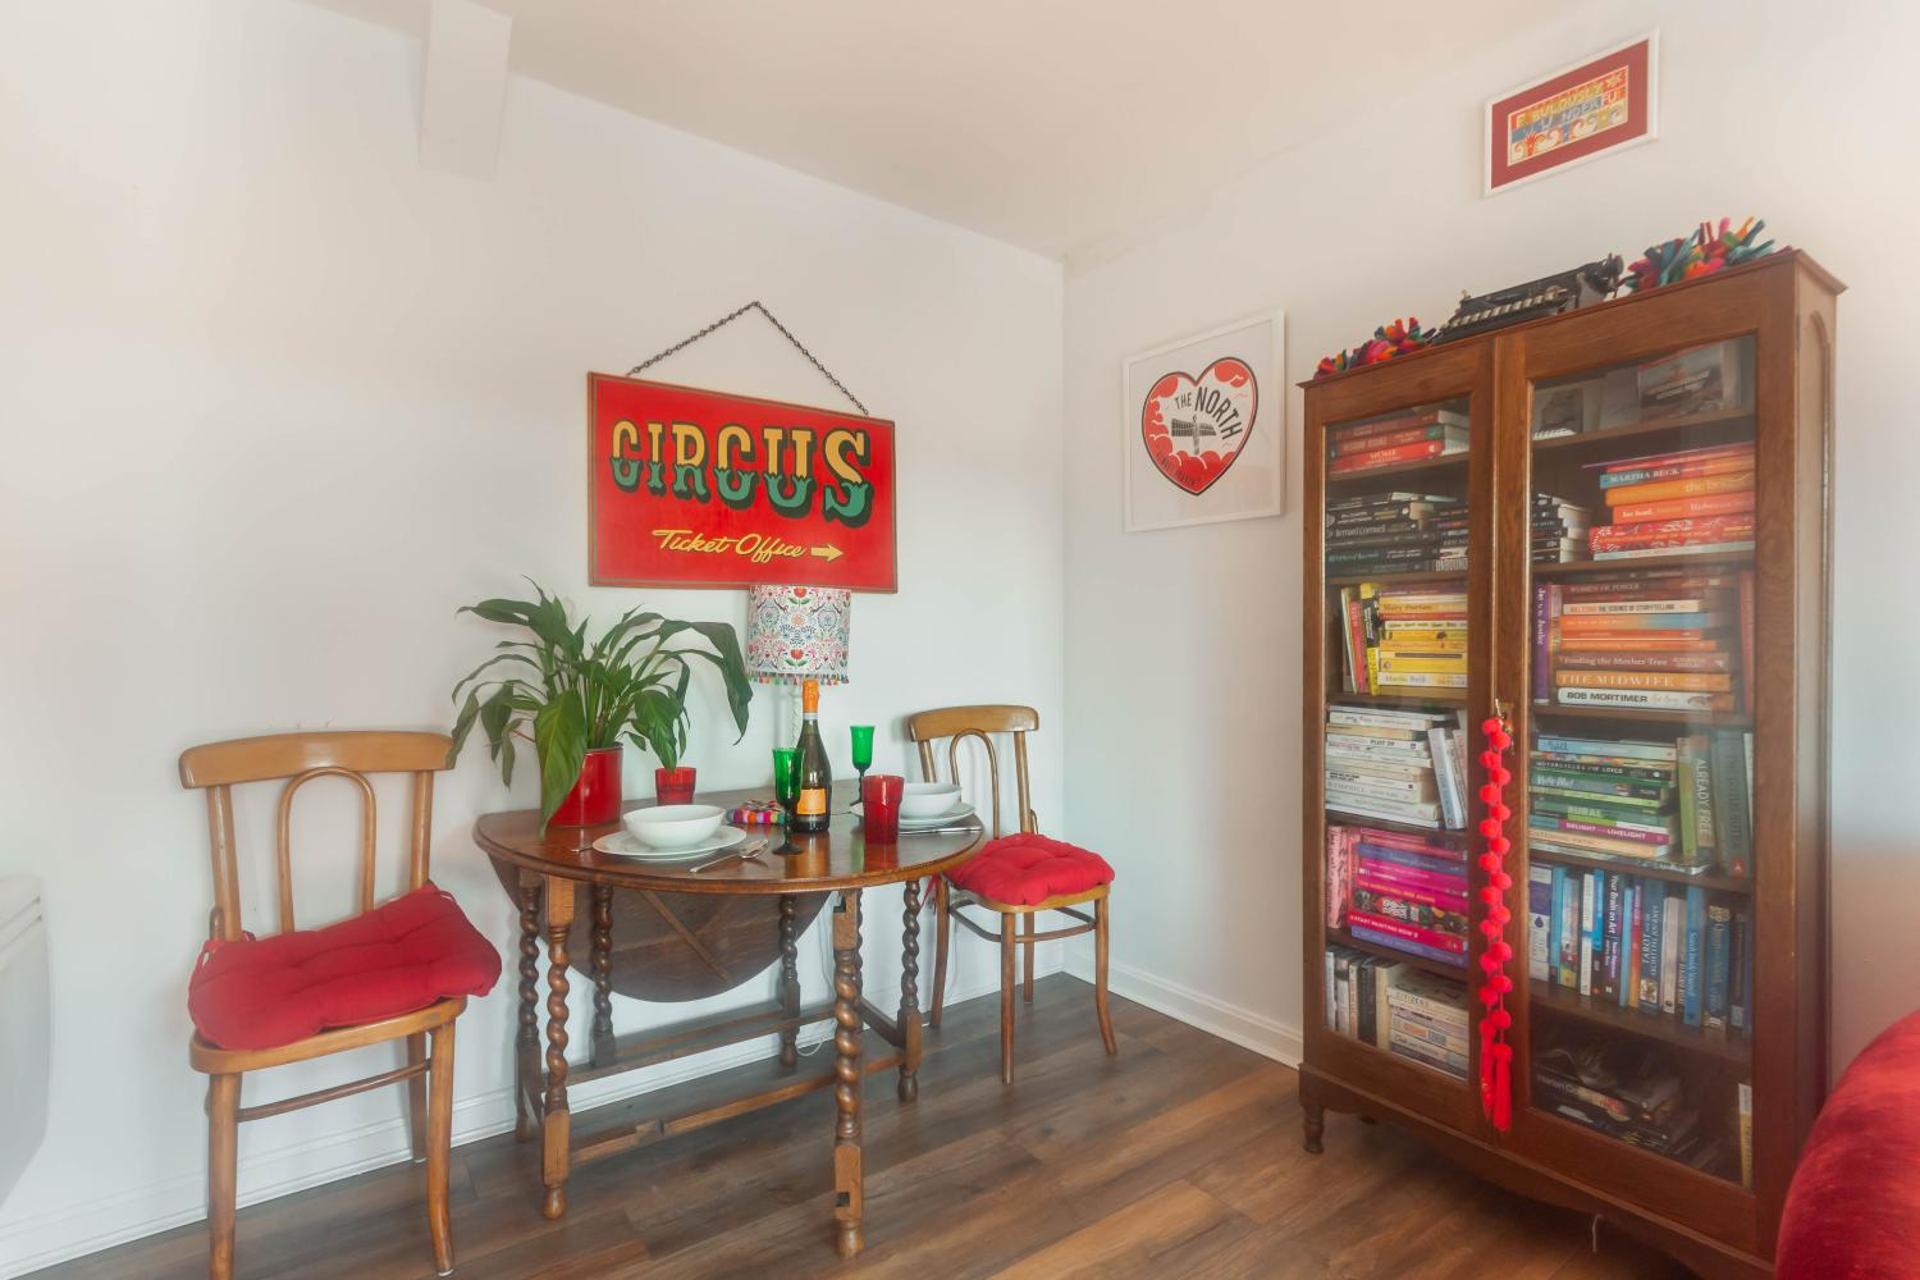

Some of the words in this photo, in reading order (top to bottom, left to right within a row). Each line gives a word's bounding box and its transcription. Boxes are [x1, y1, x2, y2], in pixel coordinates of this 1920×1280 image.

[1175, 392, 1192, 410] THE
[1195, 386, 1243, 440] NORTH
[611, 420, 874, 528] CIRCUS
[1609, 470, 1651, 483] MARTHA
[652, 529, 735, 555] Ticket
[735, 533, 806, 563] Office
[1597, 656, 1612, 666] the
[1613, 657, 1646, 666] Mother
[1647, 658, 1667, 666] Tree
[1561, 673, 1592, 685] THE
[1597, 674, 1675, 687] MIDWIFE
[1567, 692, 1588, 700] BOB
[1589, 692, 1648, 703] MORTIMER
[1695, 758, 1711, 807] ALREADY
[1566, 822, 1597, 833] DELIGHT
[1606, 828, 1647, 840] LIMELIGHT
[1697, 805, 1713, 836] FREE
[1608, 924, 1616, 934] Art
[1642, 933, 1651, 963] TAROT
